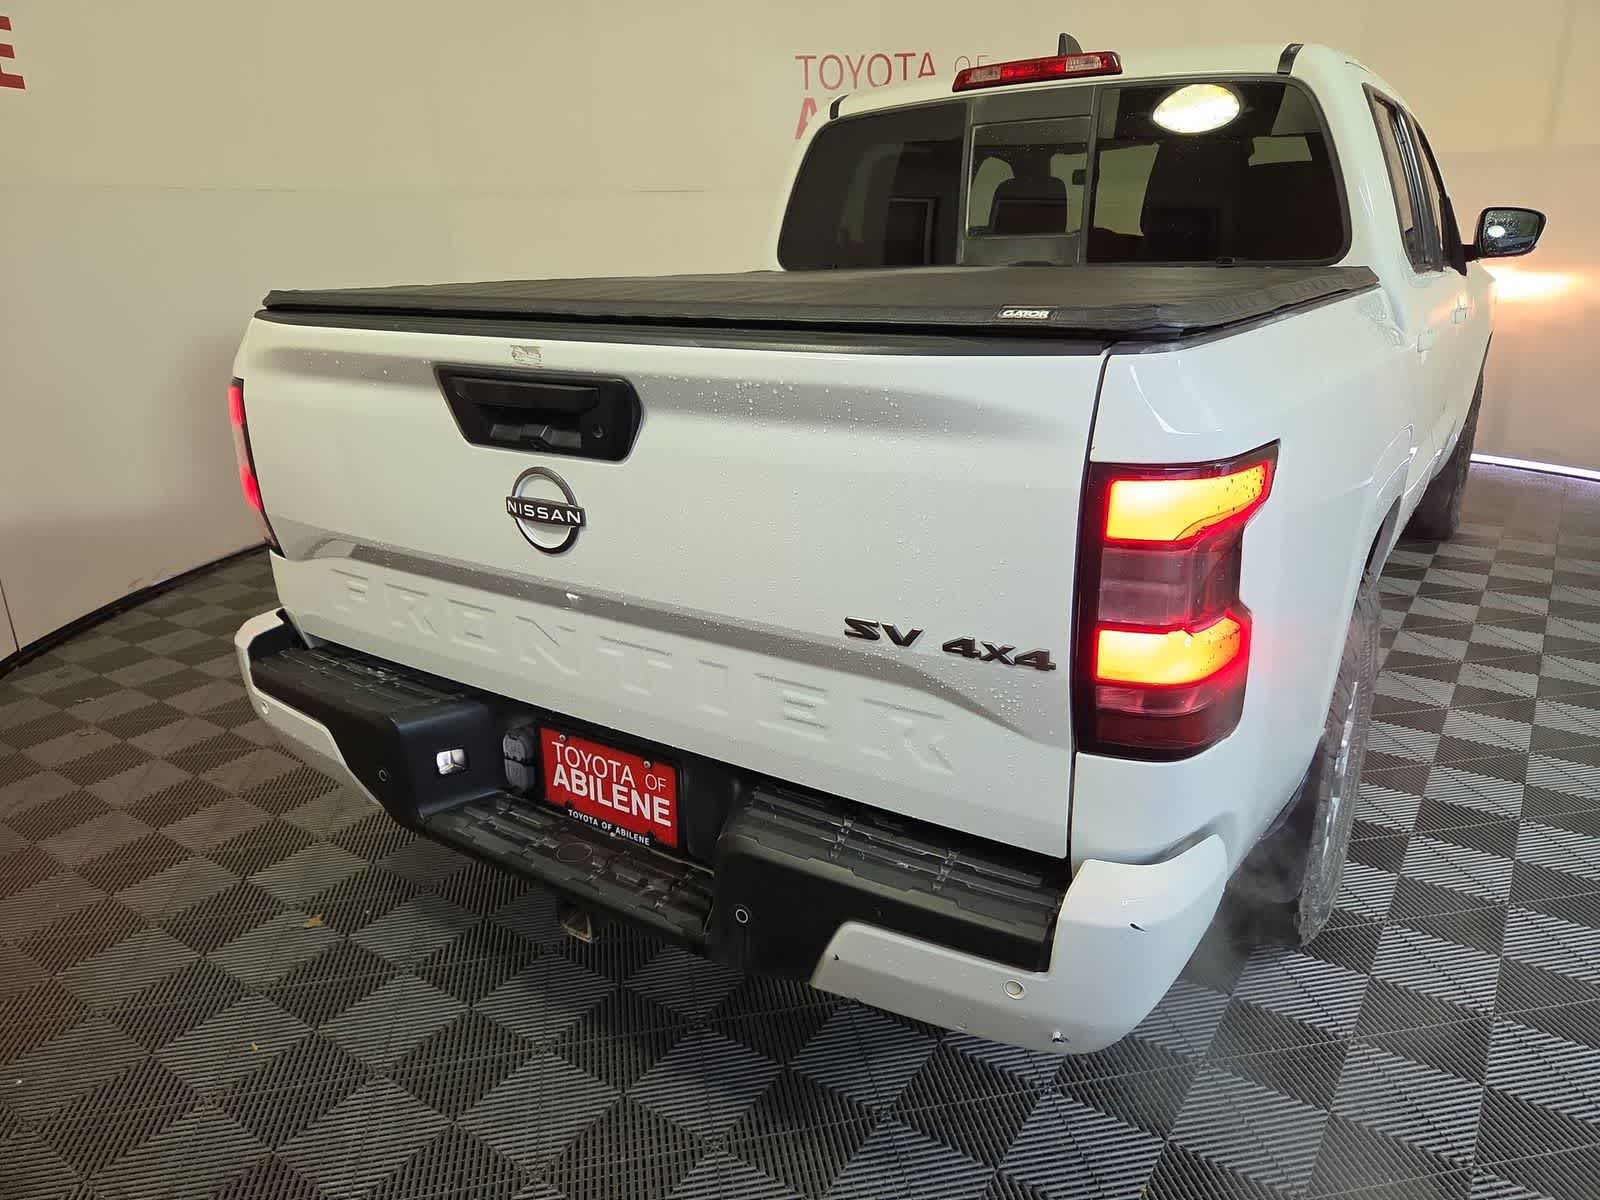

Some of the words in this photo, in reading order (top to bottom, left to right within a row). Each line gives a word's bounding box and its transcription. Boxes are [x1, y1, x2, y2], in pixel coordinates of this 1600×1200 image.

[795, 52, 936, 90] TOYOTA
[1001, 309, 1050, 319] GATOR
[507, 500, 581, 524] NISSAN
[844, 616, 924, 647] SV
[552, 741, 636, 789] TOYOTA
[645, 773, 667, 792] OF
[553, 764, 672, 828] ABILENE
[567, 809, 599, 827] TOYOTA
[601, 821, 613, 831] OF
[615, 827, 651, 846] ABILENE
